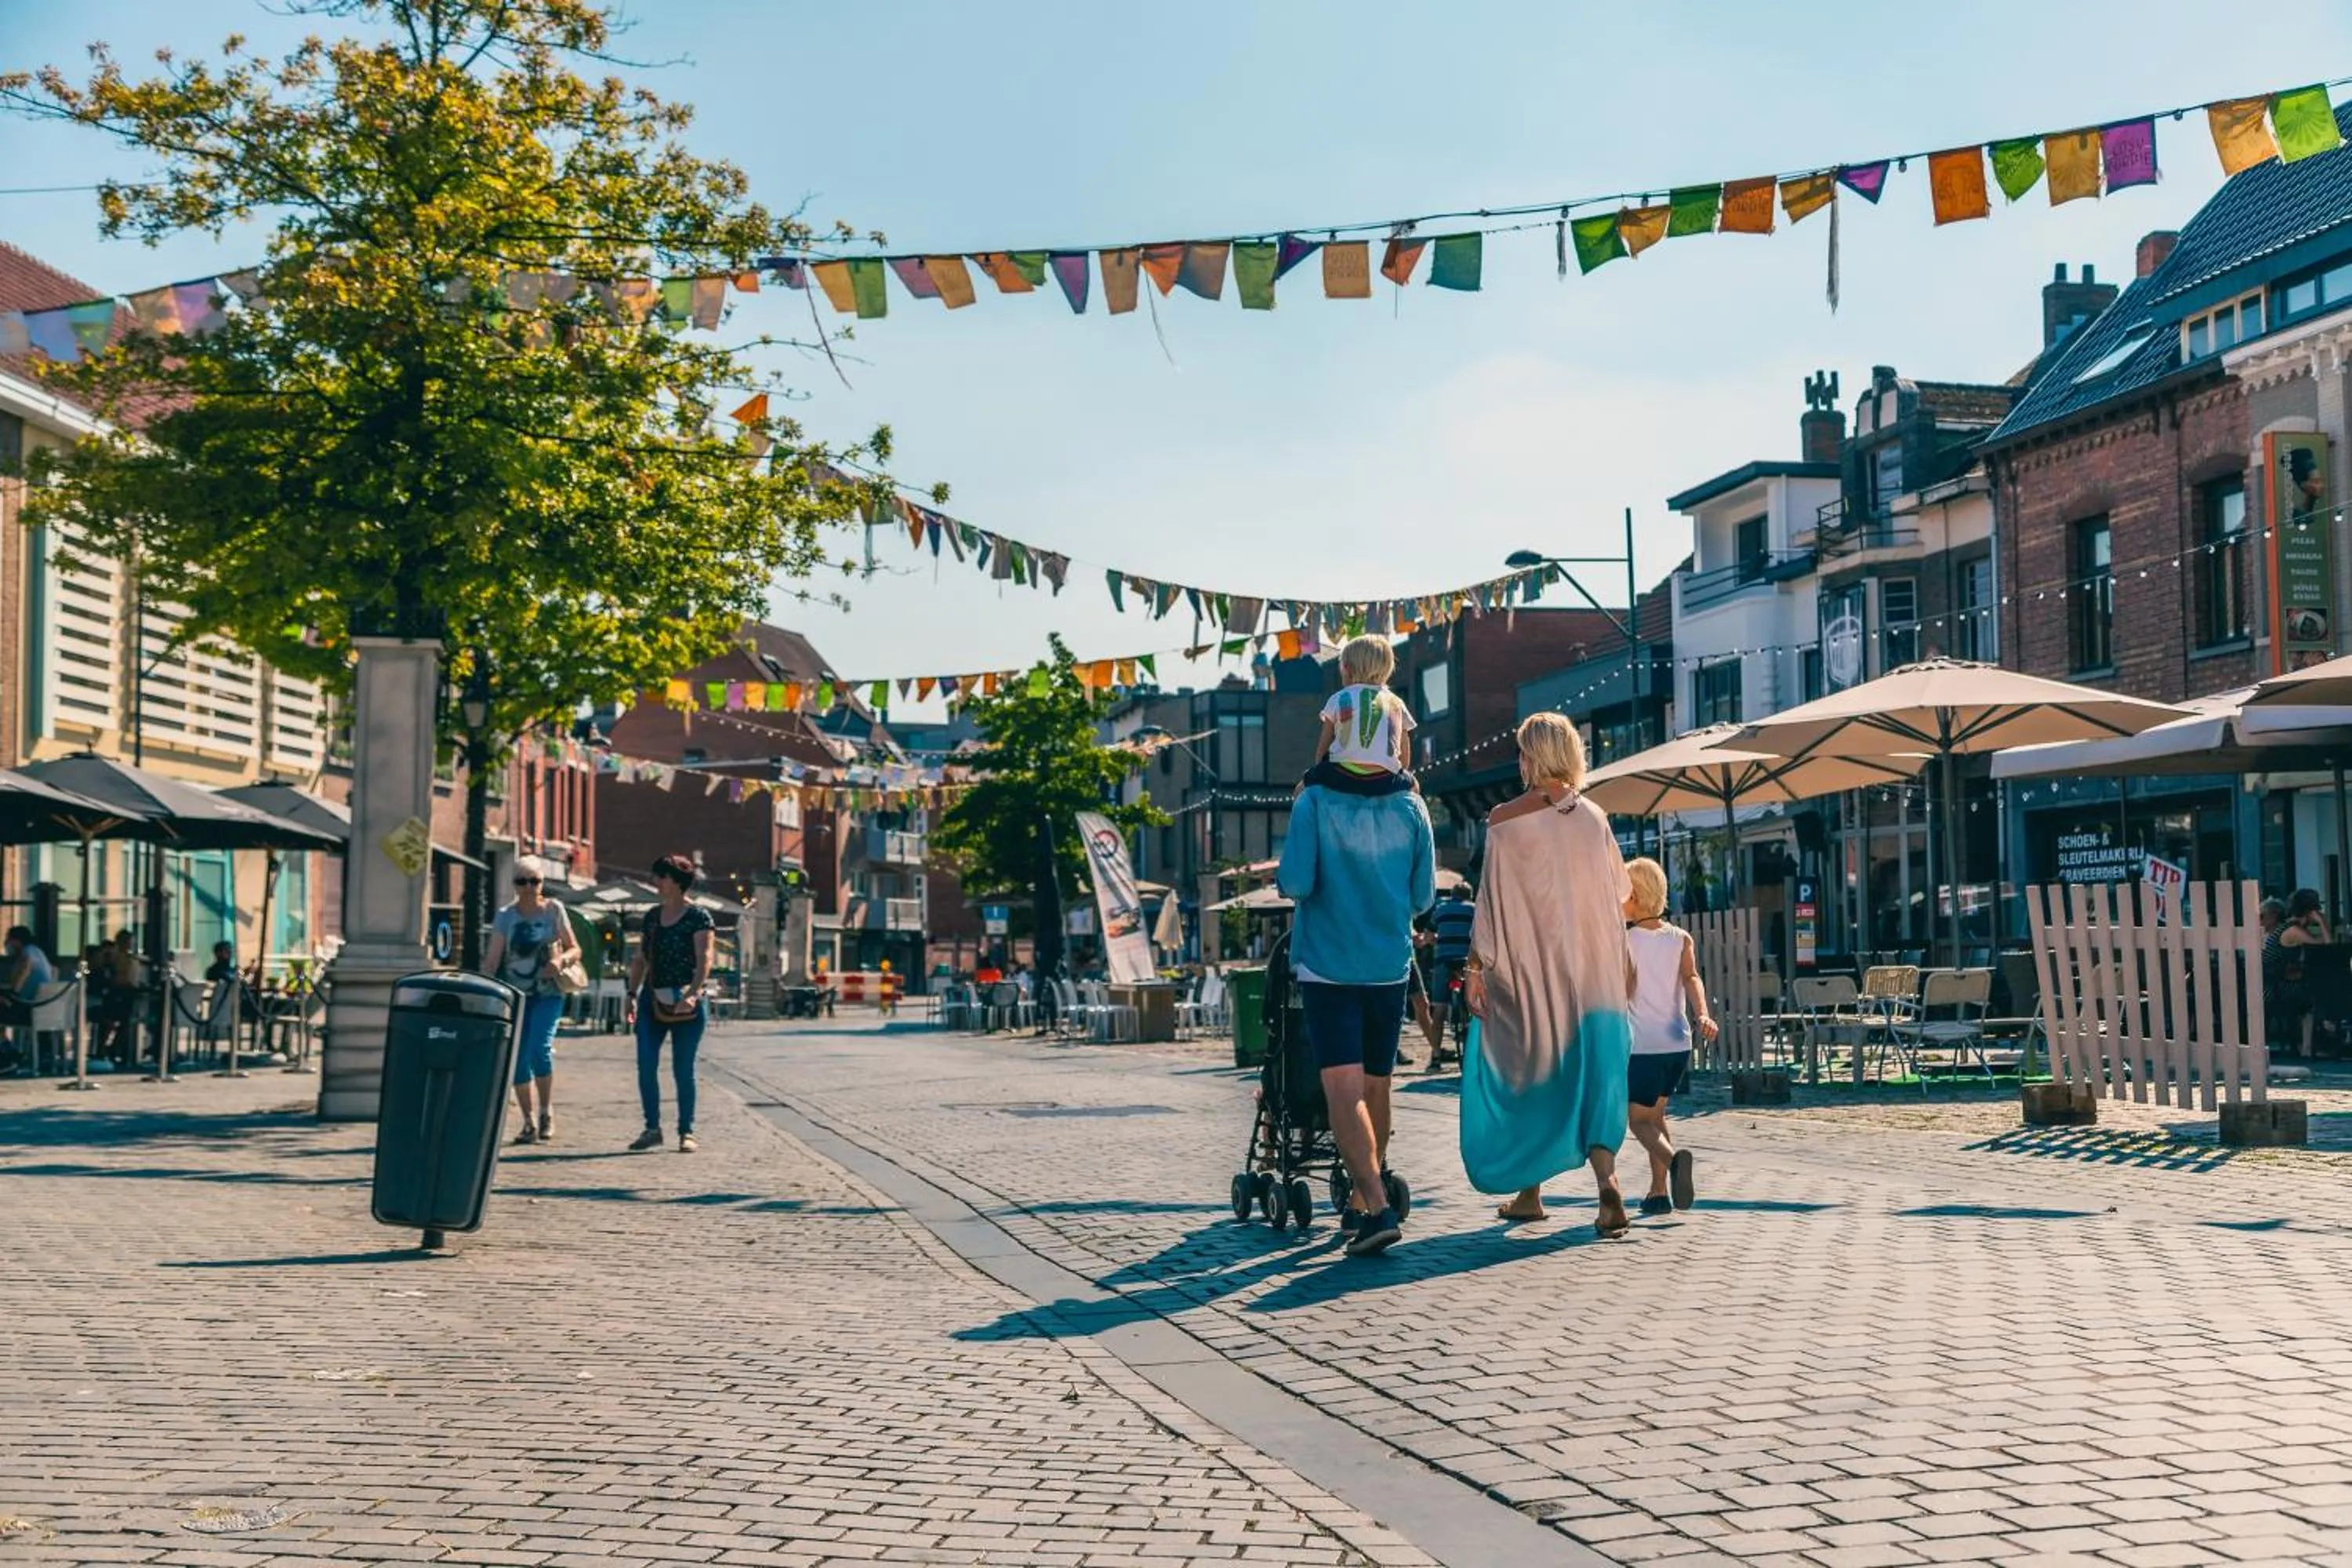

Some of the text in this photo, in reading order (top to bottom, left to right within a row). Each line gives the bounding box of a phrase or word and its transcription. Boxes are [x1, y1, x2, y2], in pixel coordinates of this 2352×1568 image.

[2057, 832, 2110, 849] SCHOEN- &
[1800, 884, 1811, 902] P
